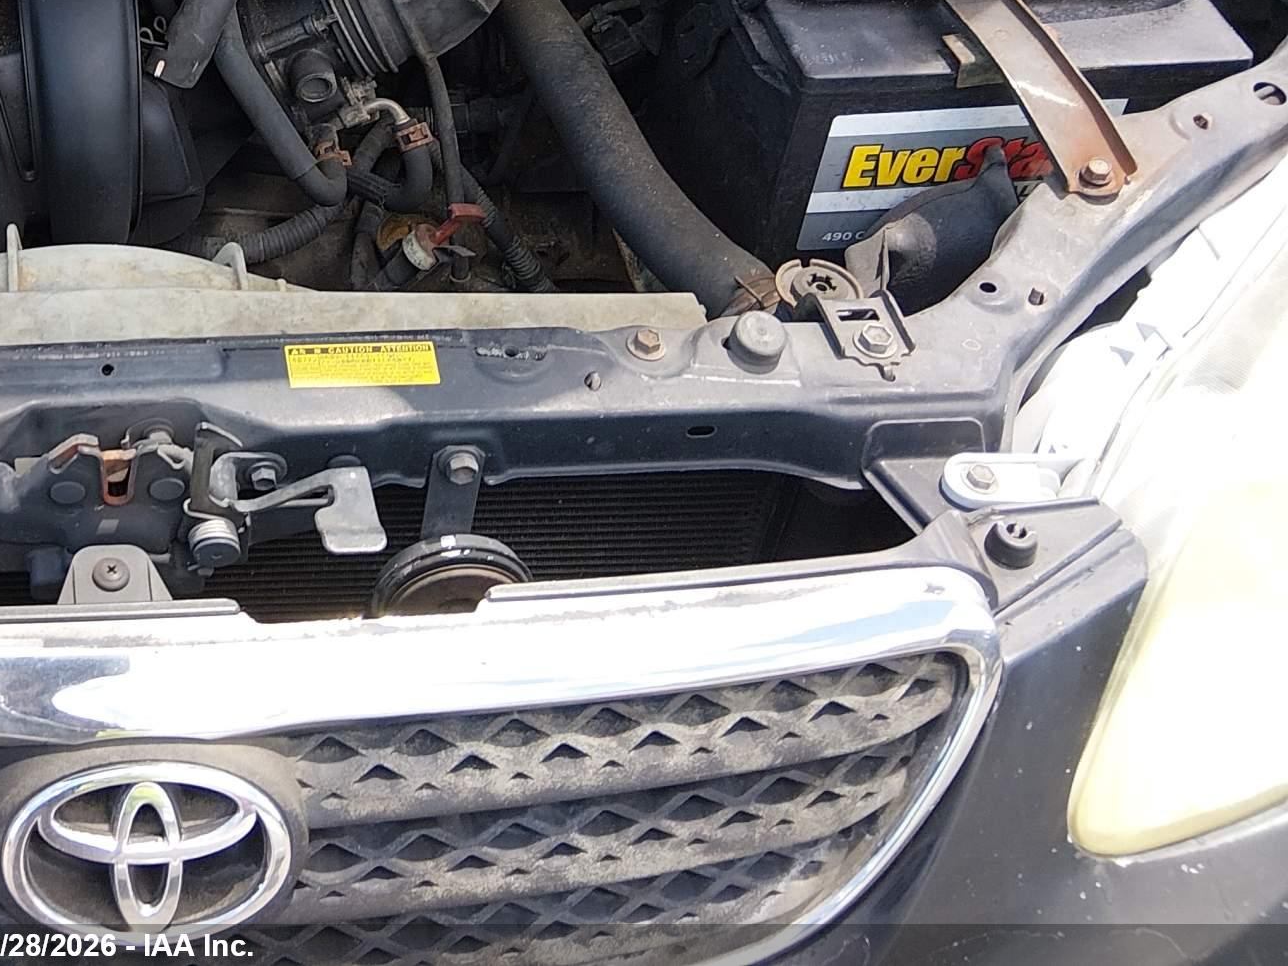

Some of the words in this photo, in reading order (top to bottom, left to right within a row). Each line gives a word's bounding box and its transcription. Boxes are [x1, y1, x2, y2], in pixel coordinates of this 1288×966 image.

[840, 136, 1055, 190] EverSta
[822, 231, 853, 242] 490
[327, 345, 373, 354] CAUTION
[380, 344, 430, 353] ATTENTION
